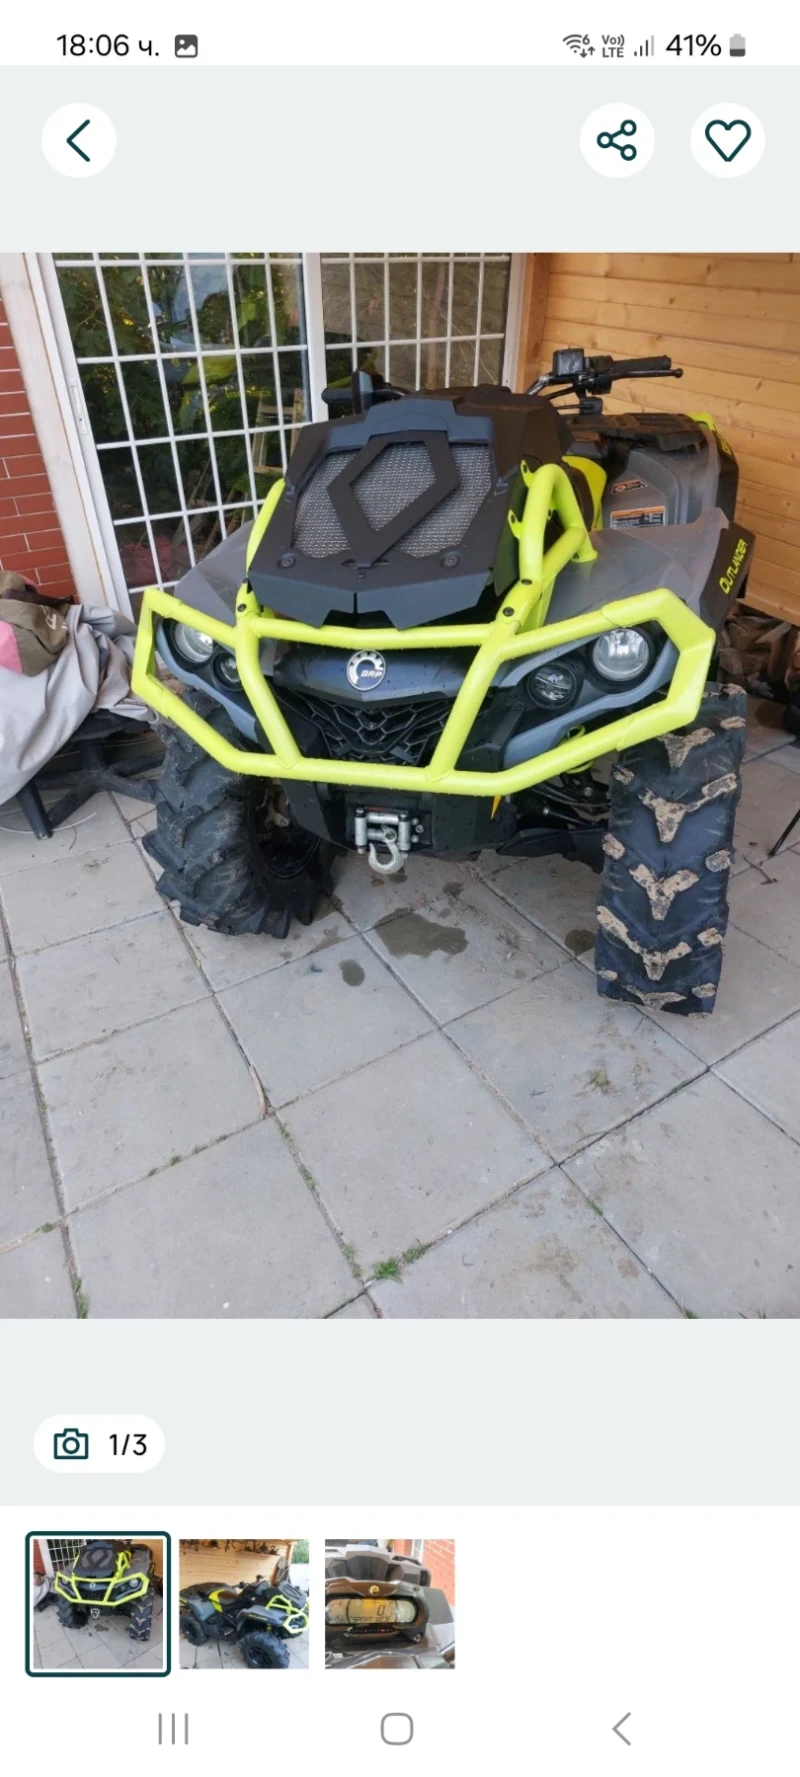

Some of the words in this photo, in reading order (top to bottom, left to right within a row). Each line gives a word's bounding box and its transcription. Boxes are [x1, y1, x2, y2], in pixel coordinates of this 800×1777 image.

[56, 33, 130, 57] 18:06
[138, 39, 160, 57] ч.
[602, 47, 625, 58] LTE
[665, 33, 722, 57] 41%
[719, 538, 748, 594] OUTLANDER
[360, 670, 383, 678] BRP
[109, 1433, 148, 1457] 1/3
